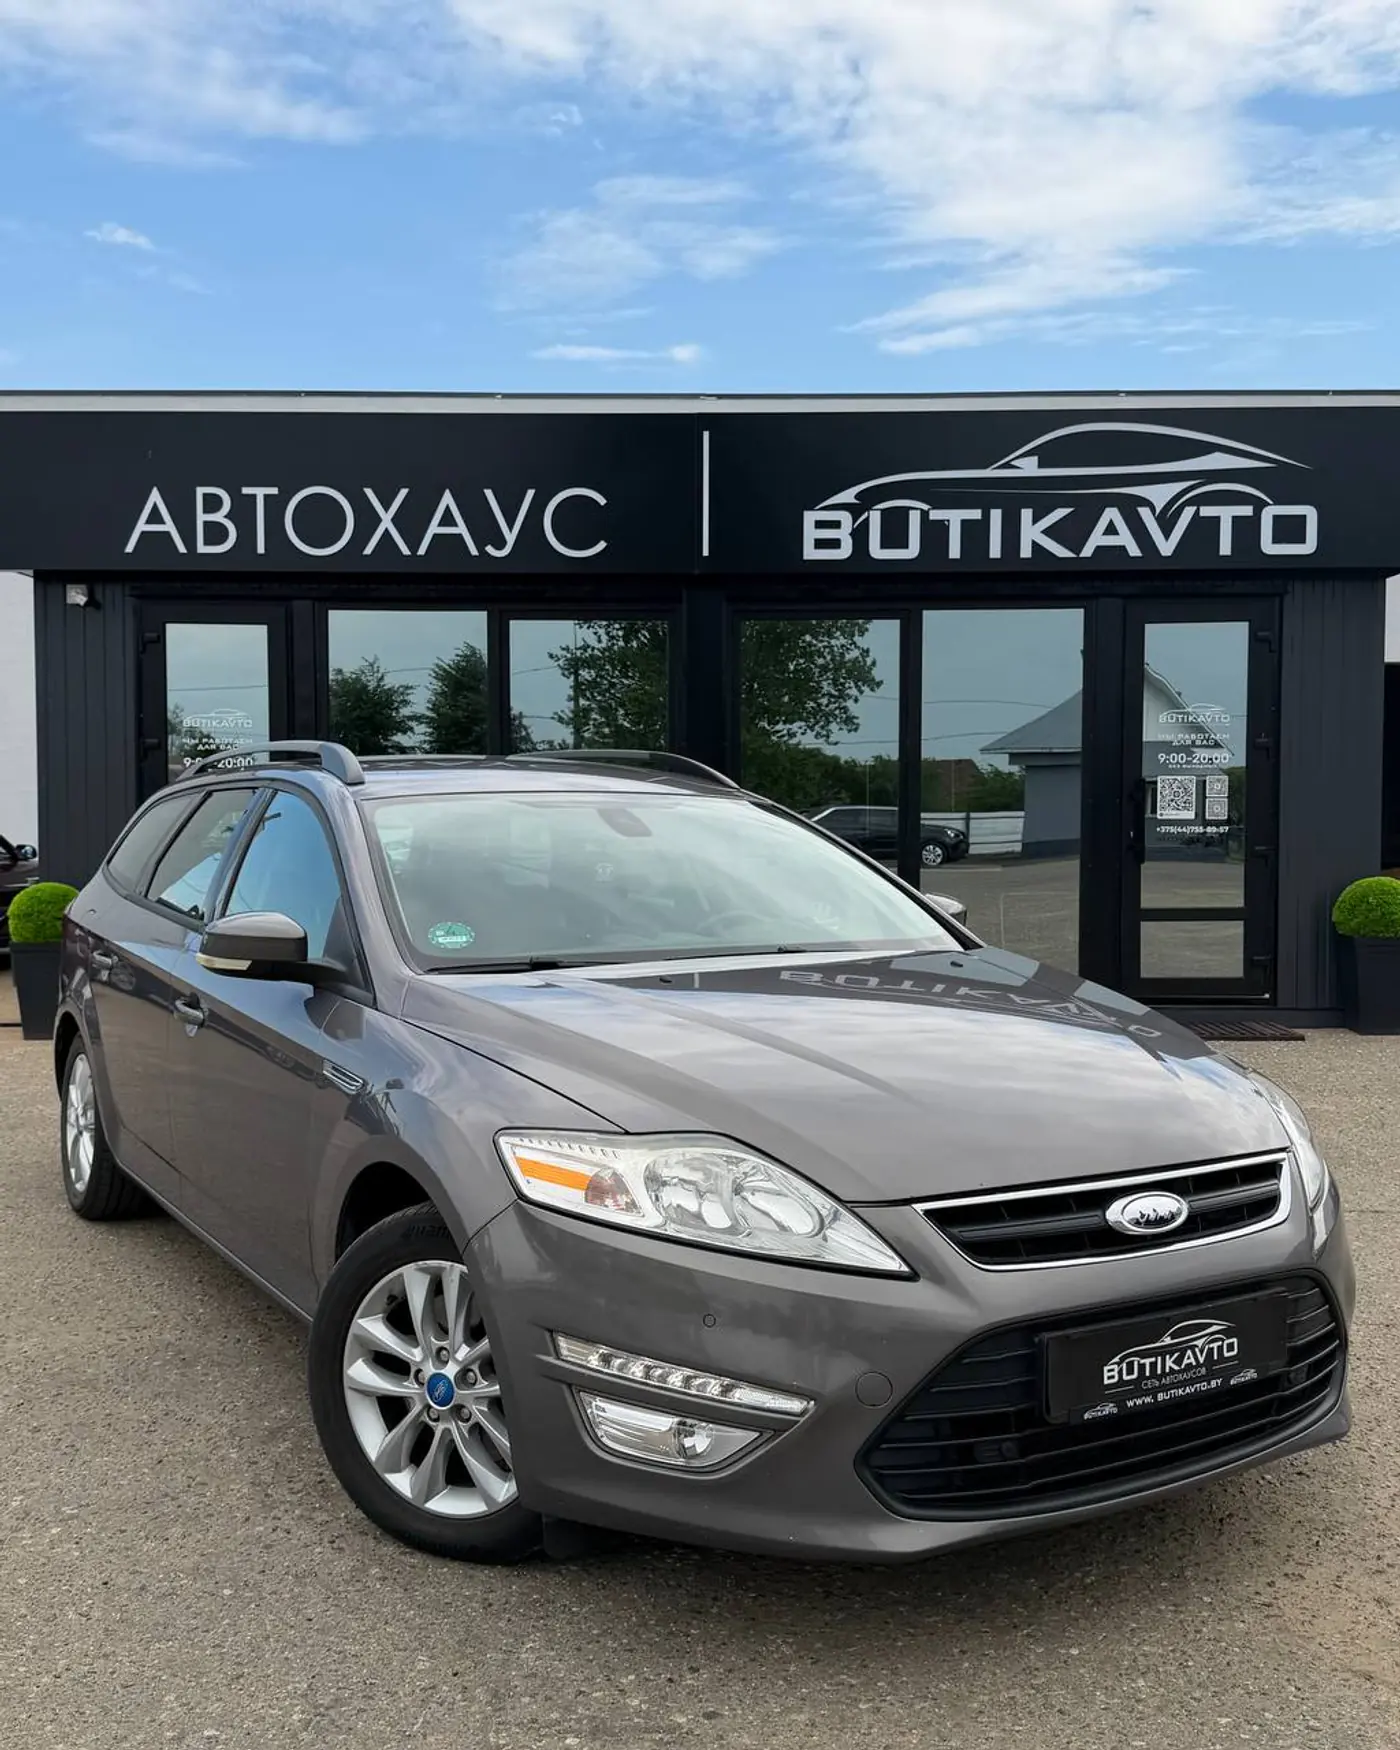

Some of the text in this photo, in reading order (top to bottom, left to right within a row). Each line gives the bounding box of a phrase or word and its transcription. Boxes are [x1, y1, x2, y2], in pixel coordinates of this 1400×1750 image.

[124, 485, 608, 558] АВТОХАУС
[802, 504, 1318, 561] BUTIKAVTO
[1158, 753, 1230, 765] 9:00-20:00
[1103, 1337, 1239, 1385] BUTIKAVTO
